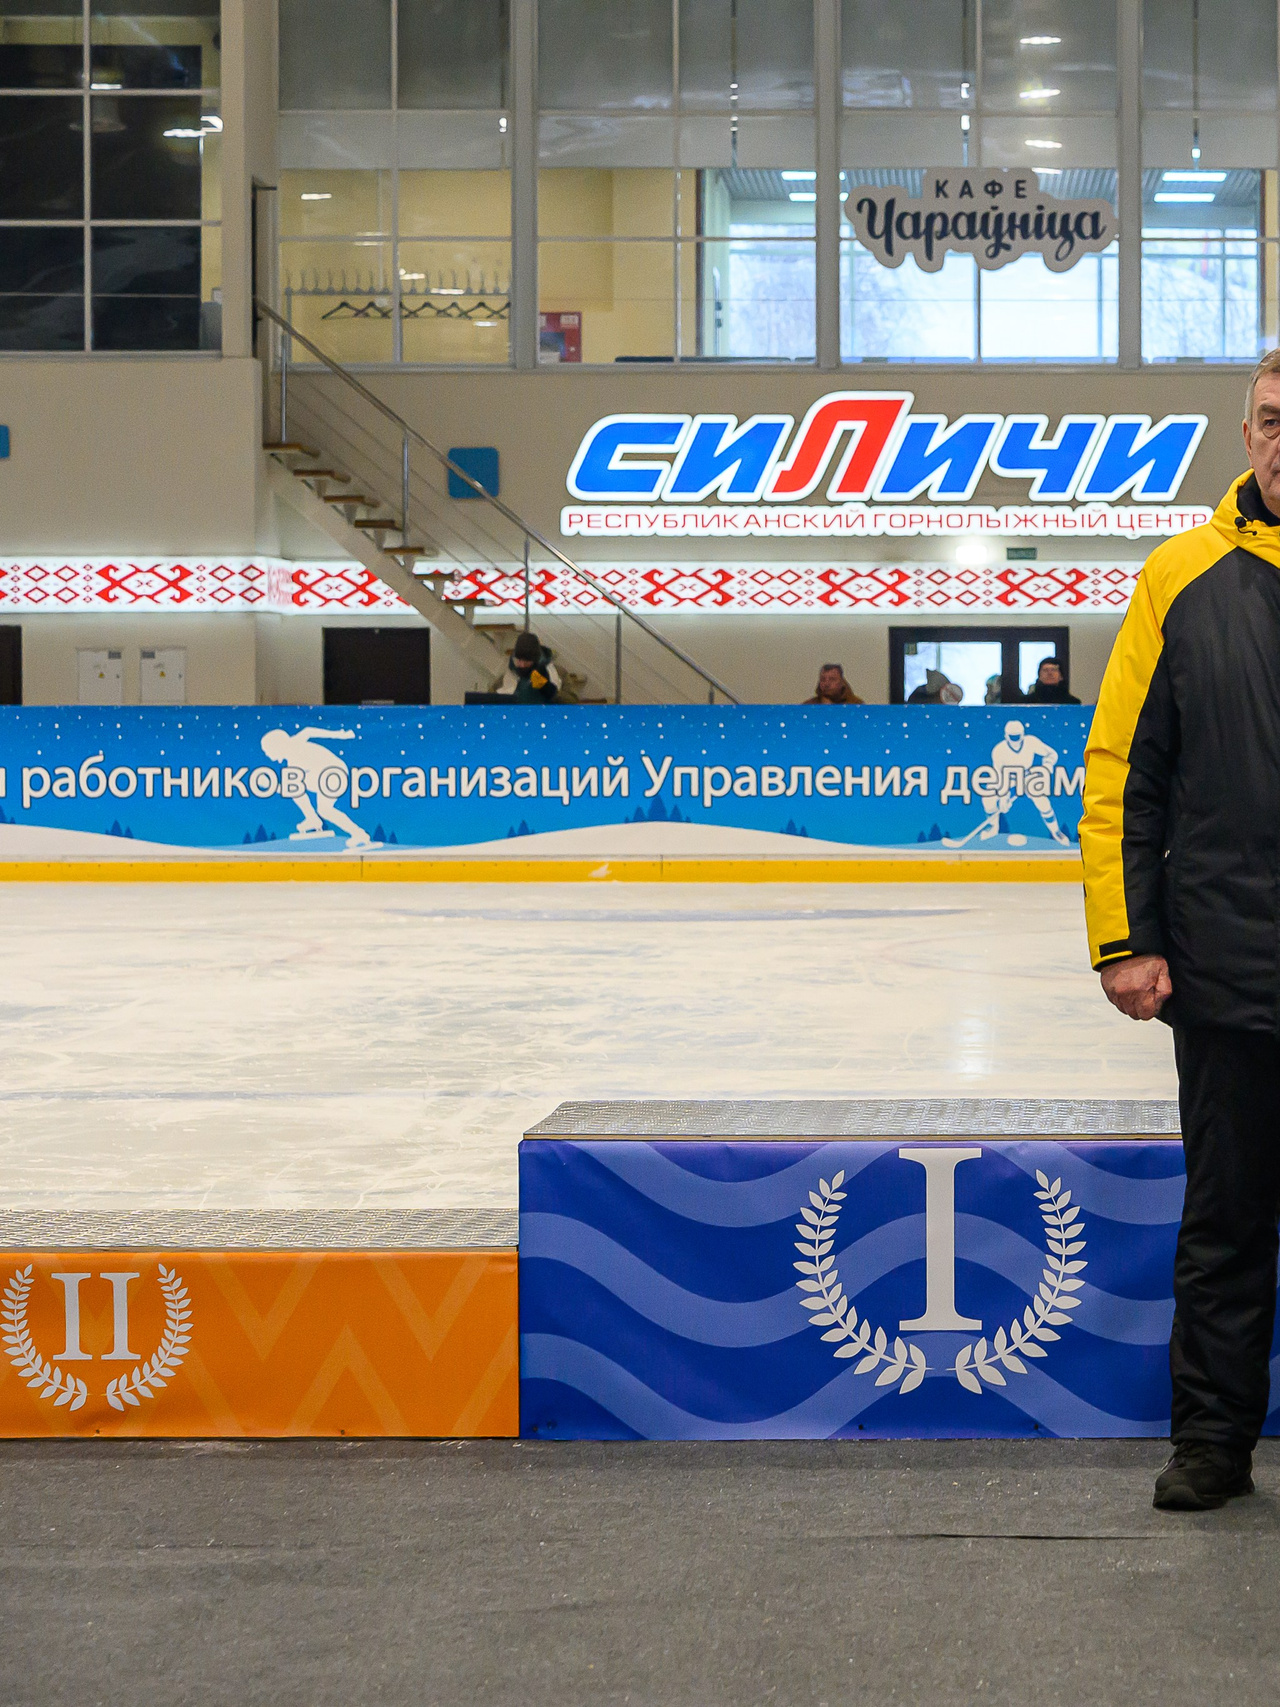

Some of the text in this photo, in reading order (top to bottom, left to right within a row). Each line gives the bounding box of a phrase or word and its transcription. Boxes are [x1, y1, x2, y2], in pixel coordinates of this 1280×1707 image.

[935, 179, 1027, 198] КАФЕ
[856, 198, 1106, 261] Чараўніца
[568, 509, 1208, 531] РЕСПУБЛИКАНСКИЙ ГОРНОЛЫЖНЫЙ ЦЕНТР
[22, 753, 306, 809] работников
[318, 755, 630, 809] организаций
[641, 755, 928, 808] Управления
[899, 1147, 983, 1331] I
[51, 1272, 141, 1360] II
